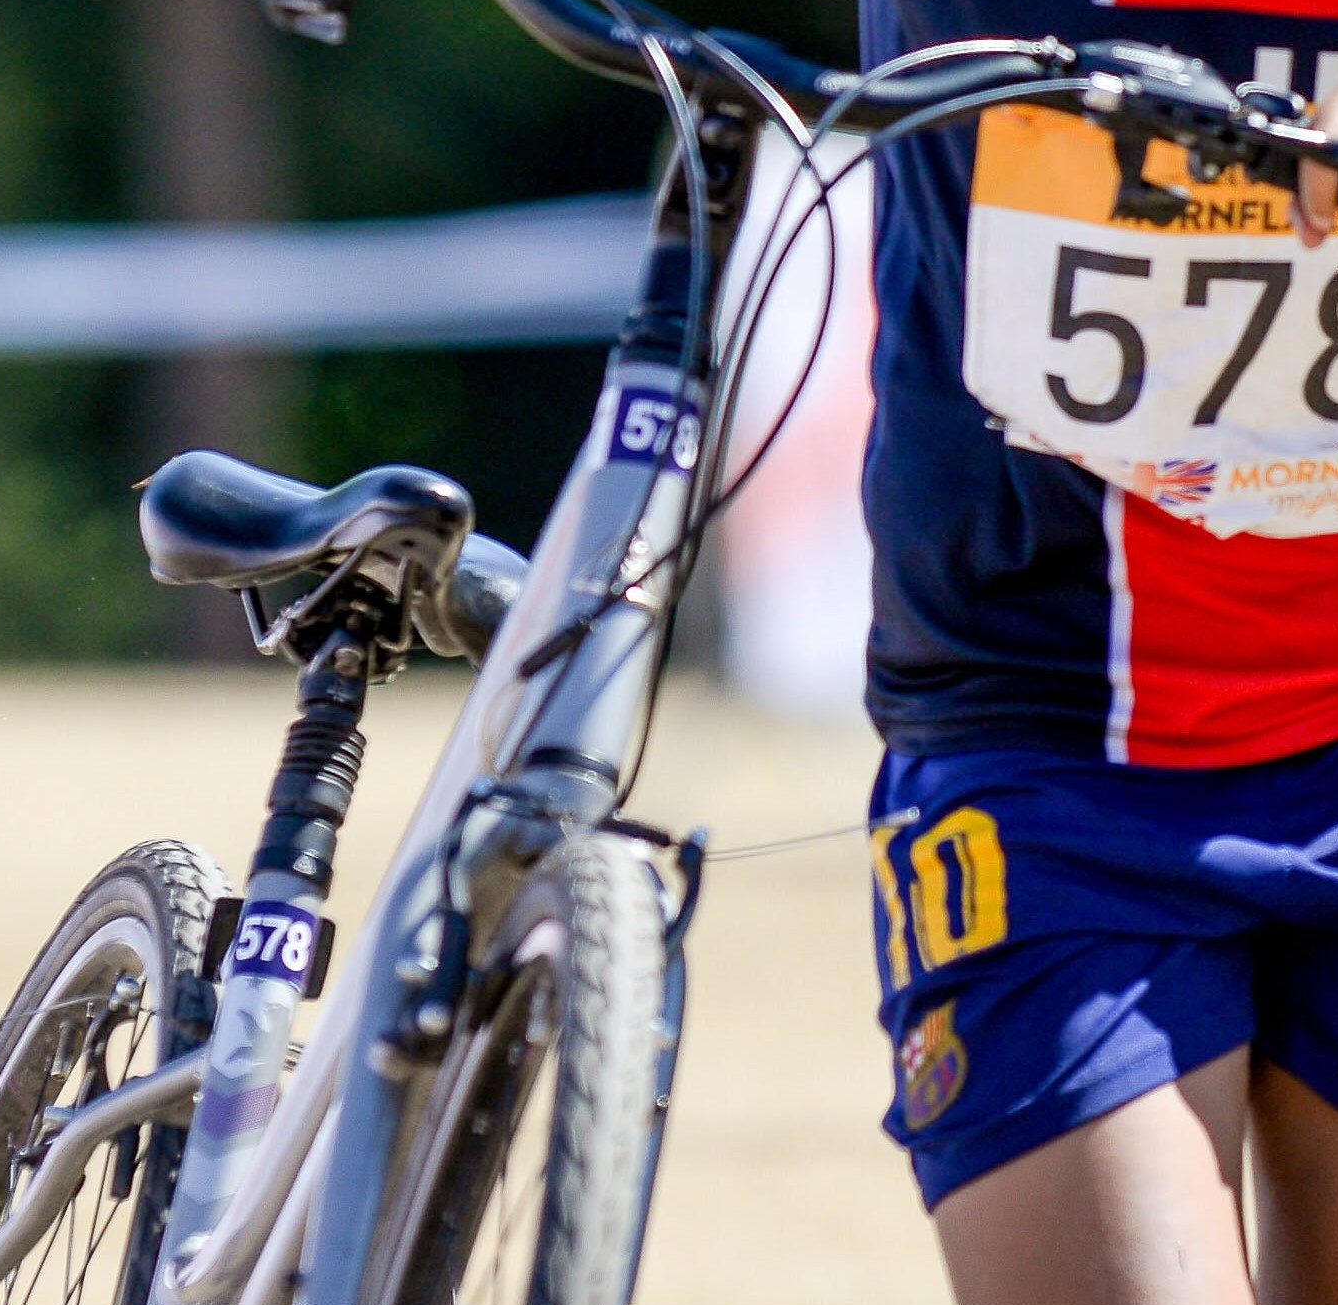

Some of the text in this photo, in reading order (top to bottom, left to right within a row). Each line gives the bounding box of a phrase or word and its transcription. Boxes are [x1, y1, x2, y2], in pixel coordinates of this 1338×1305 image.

[620, 398, 701, 470] 578
[868, 806, 1008, 991] 10
[235, 915, 313, 972] 578
